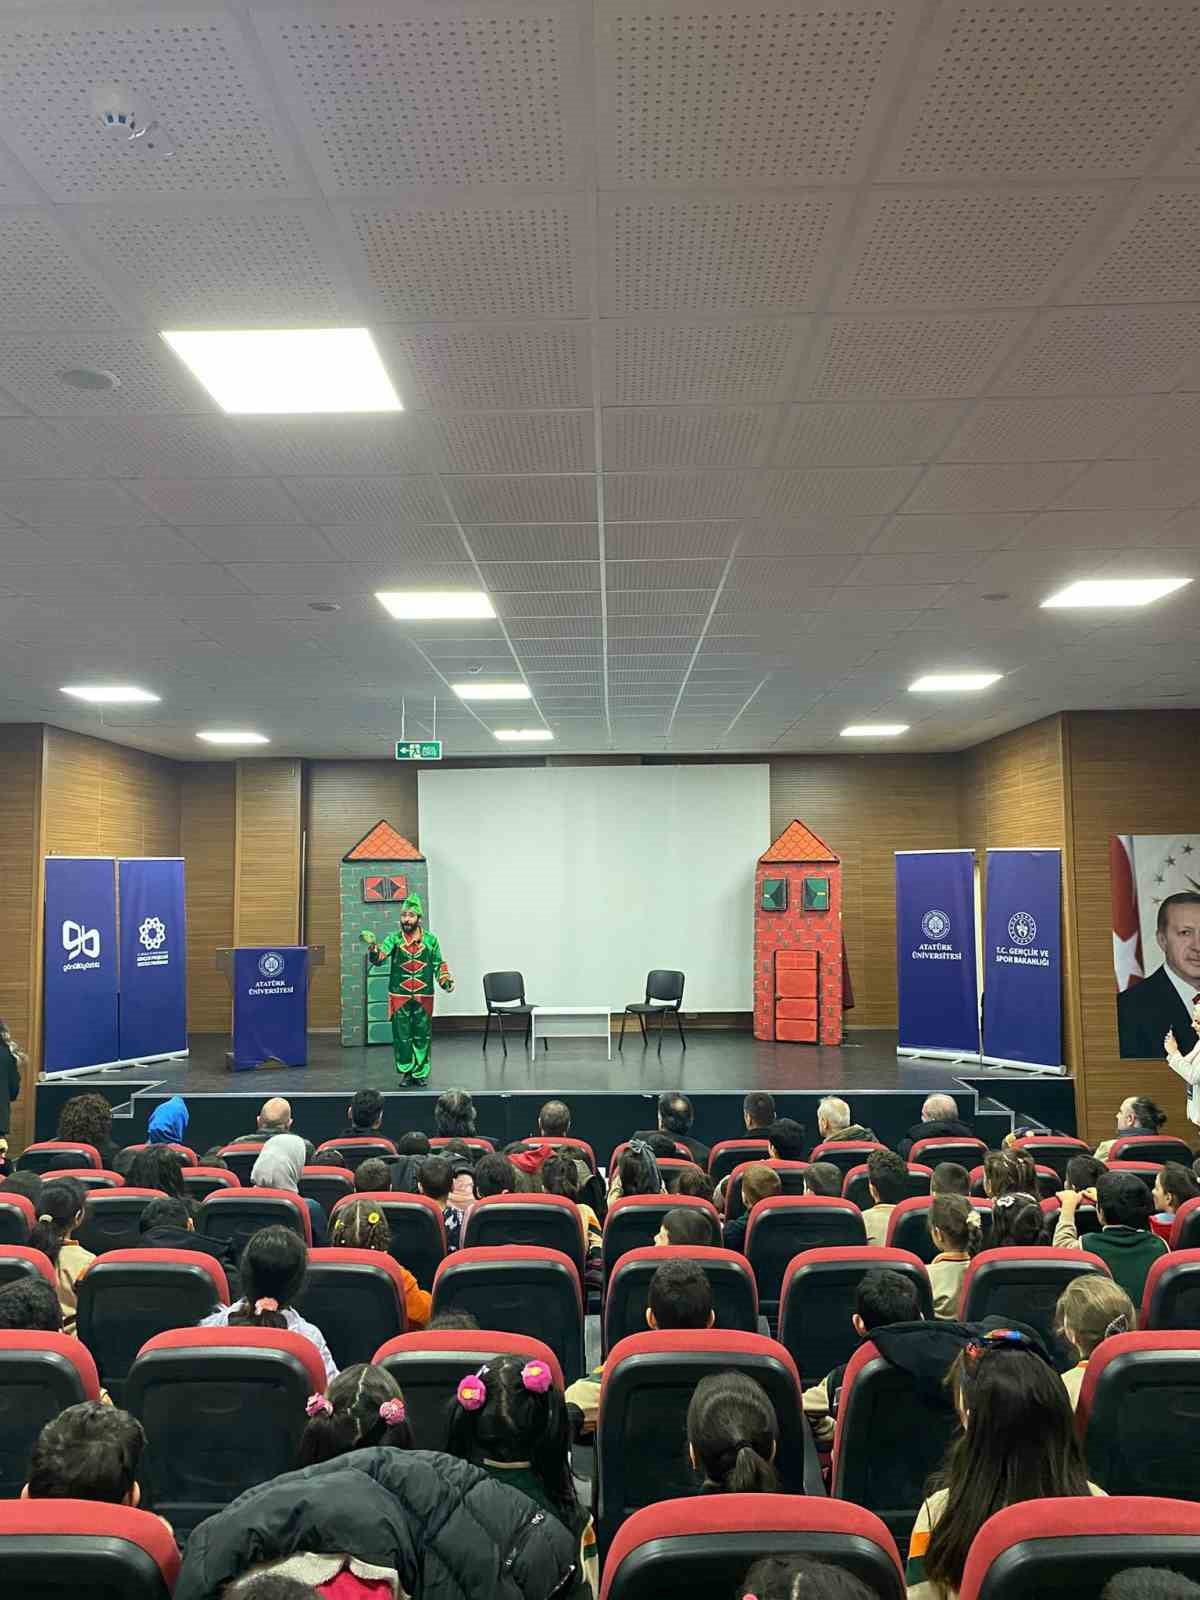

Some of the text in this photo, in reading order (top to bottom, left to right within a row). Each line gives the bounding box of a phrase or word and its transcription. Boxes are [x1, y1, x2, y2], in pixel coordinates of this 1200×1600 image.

[919, 942, 952, 951] ATATÜRK
[1040, 949, 1049, 958] VE
[995, 955, 1013, 964] SPOR
